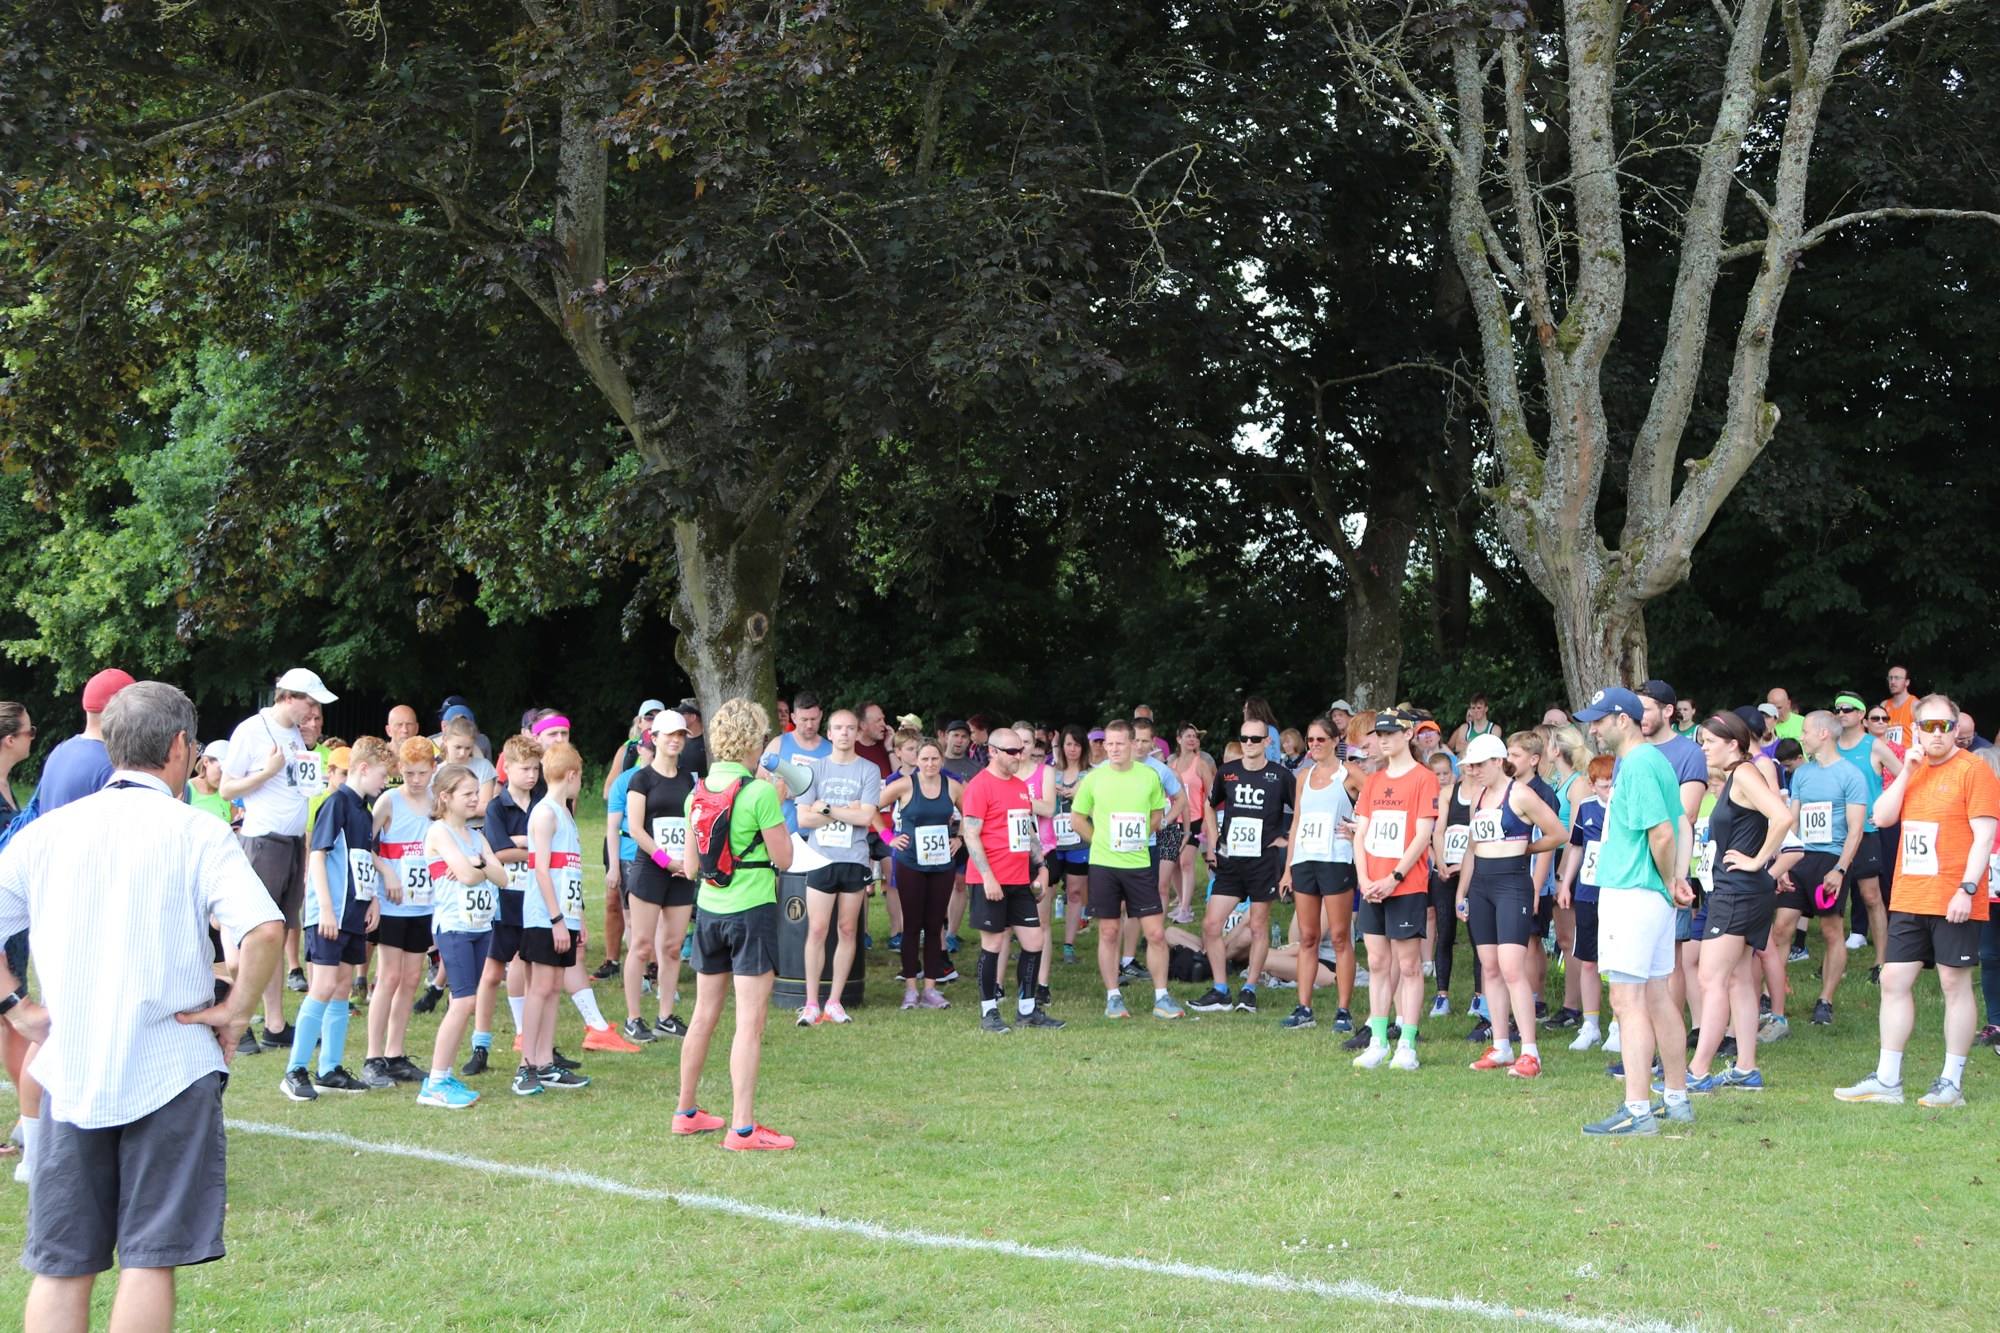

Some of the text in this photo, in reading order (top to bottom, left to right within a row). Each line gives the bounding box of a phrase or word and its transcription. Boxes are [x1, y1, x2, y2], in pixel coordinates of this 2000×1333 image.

[299, 761, 316, 781] 93
[1235, 783, 1266, 805] ttc
[1806, 811, 1826, 829] 108
[661, 827, 686, 845] 563
[1119, 822, 1141, 838] 164
[1231, 826, 1256, 842] 558
[1300, 822, 1323, 839] 541
[1374, 822, 1399, 840] 140
[1475, 820, 1496, 840] 139
[922, 834, 946, 852] 554
[1446, 833, 1469, 850] 162
[1905, 833, 1928, 855] 145
[466, 890, 493, 911] 562
